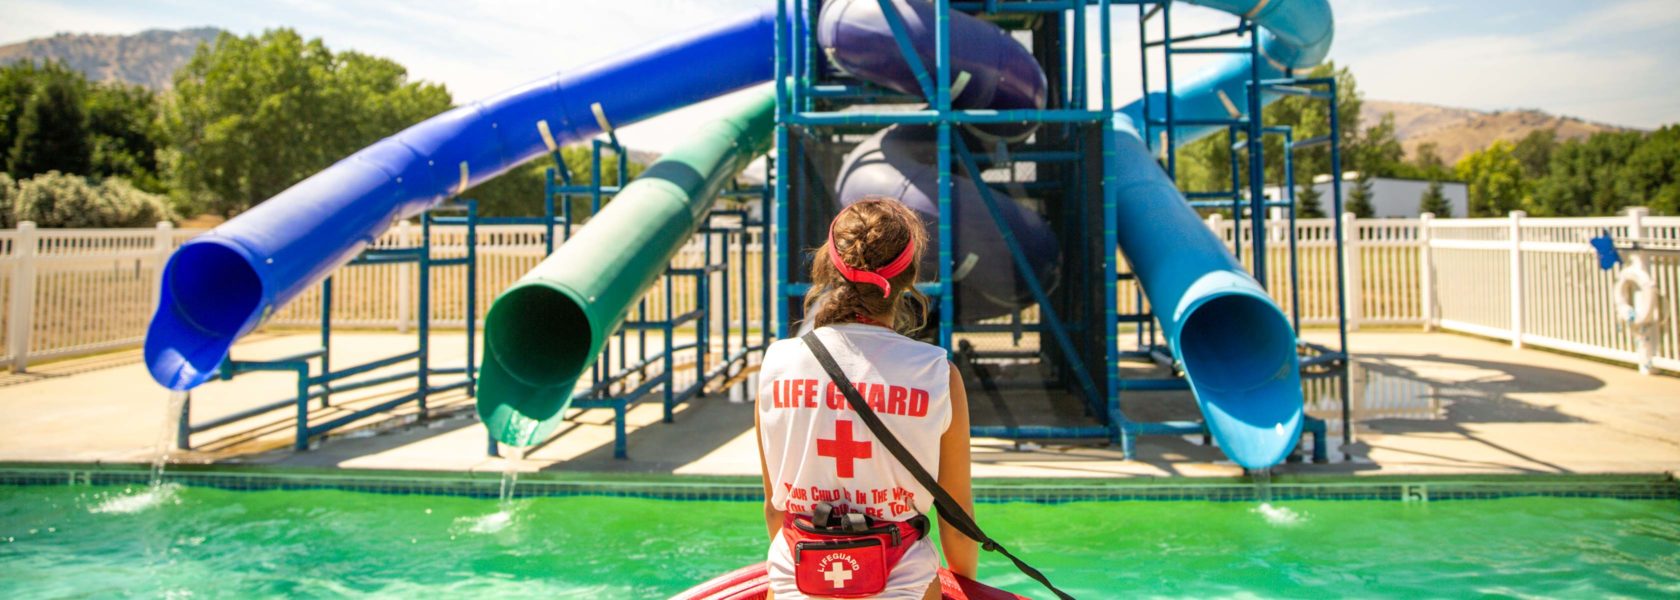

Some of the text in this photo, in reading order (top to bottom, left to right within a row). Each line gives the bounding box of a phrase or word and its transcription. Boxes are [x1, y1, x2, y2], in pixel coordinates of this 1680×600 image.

[773, 379, 819, 408] LIFE
[811, 486, 840, 502] CHILD
[856, 489, 867, 504] IN
[871, 488, 888, 504] THE
[1408, 485, 1422, 500] 5
[816, 552, 860, 573] LIFEGUARD
